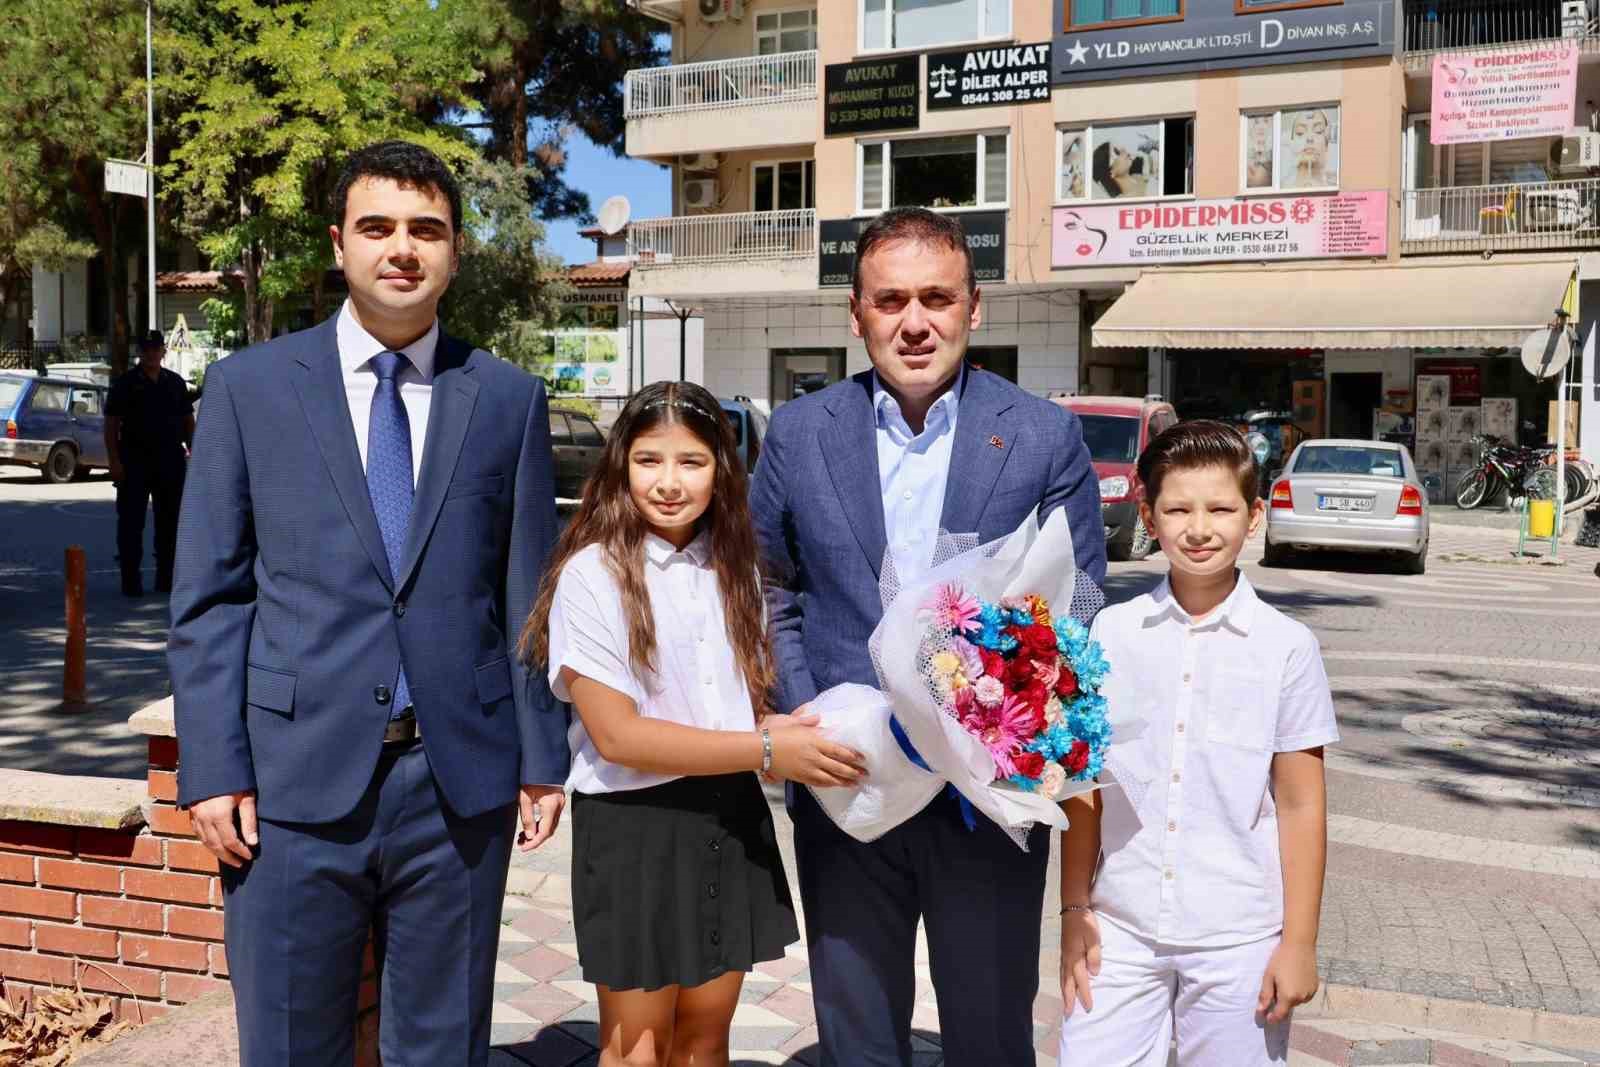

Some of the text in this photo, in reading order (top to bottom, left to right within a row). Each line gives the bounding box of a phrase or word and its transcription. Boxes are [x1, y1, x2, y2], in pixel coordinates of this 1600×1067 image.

[1094, 41, 1130, 59] YLD
[1134, 36, 1206, 54] HAYVANCILIK
[1260, 20, 1284, 48] D
[1287, 25, 1324, 40] DİVAN
[963, 46, 1049, 72] AVUKAT
[845, 64, 897, 82] AVUKAT
[962, 70, 1048, 90] DİLEK ALPER
[962, 86, 1048, 104] 0544 308 25 44
[1118, 200, 1286, 230] EPİDERMİSS
[1136, 230, 1289, 246] GÜZELLİK MERKEZİ
[821, 242, 836, 254] VE
[1182, 245, 1212, 256] Makbule
[1214, 244, 1236, 254] ALPER
[1242, 244, 1260, 254] 0530
